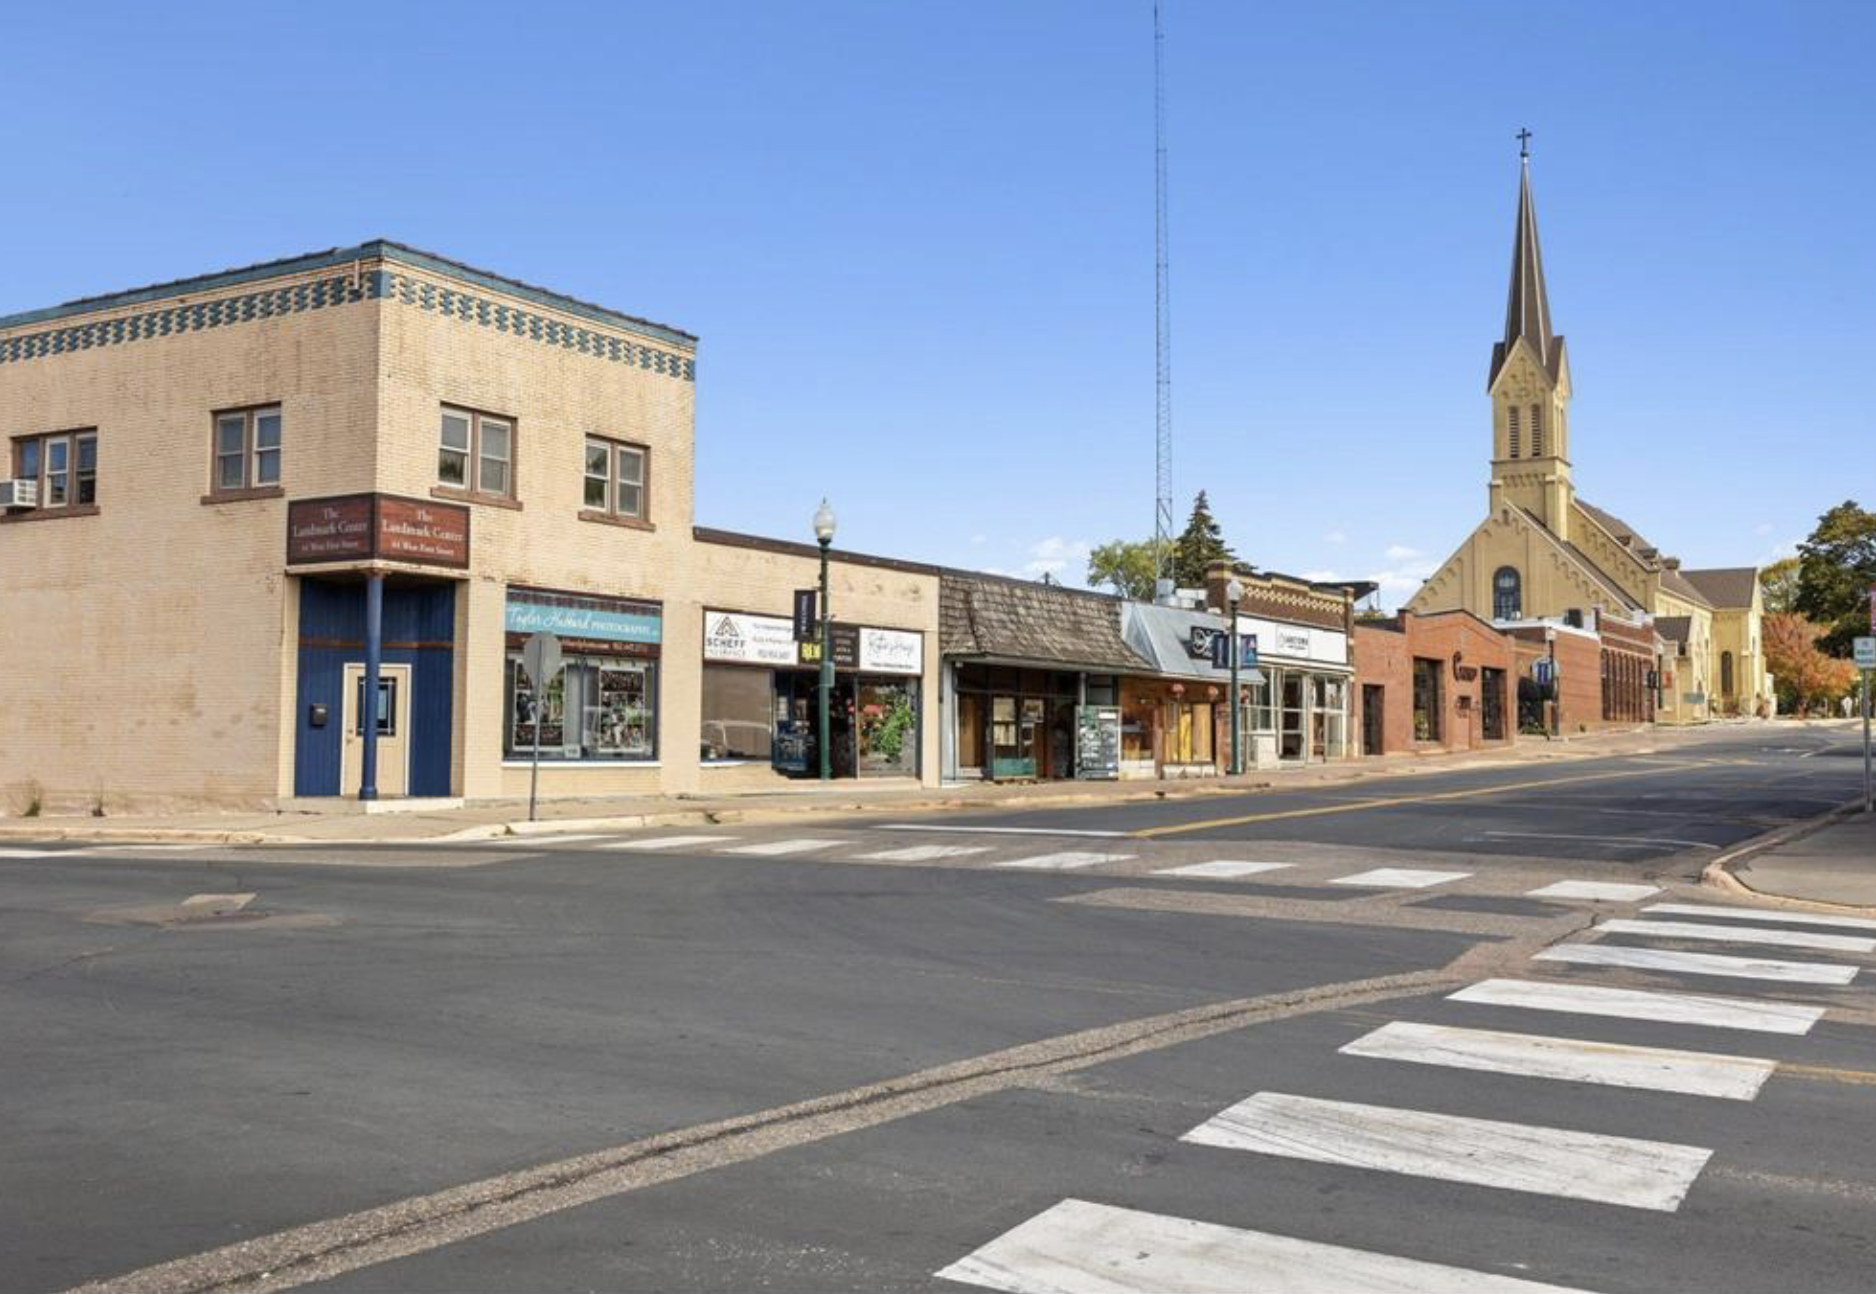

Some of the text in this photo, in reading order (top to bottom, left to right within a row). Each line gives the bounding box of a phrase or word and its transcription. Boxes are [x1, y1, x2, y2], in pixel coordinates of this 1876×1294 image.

[324, 508, 339, 520] The
[418, 510, 433, 522] The
[293, 523, 336, 537] Landmark
[382, 519, 432, 537] Landmark
[508, 605, 541, 630] Taylor
[706, 638, 747, 648] SCHEFF
